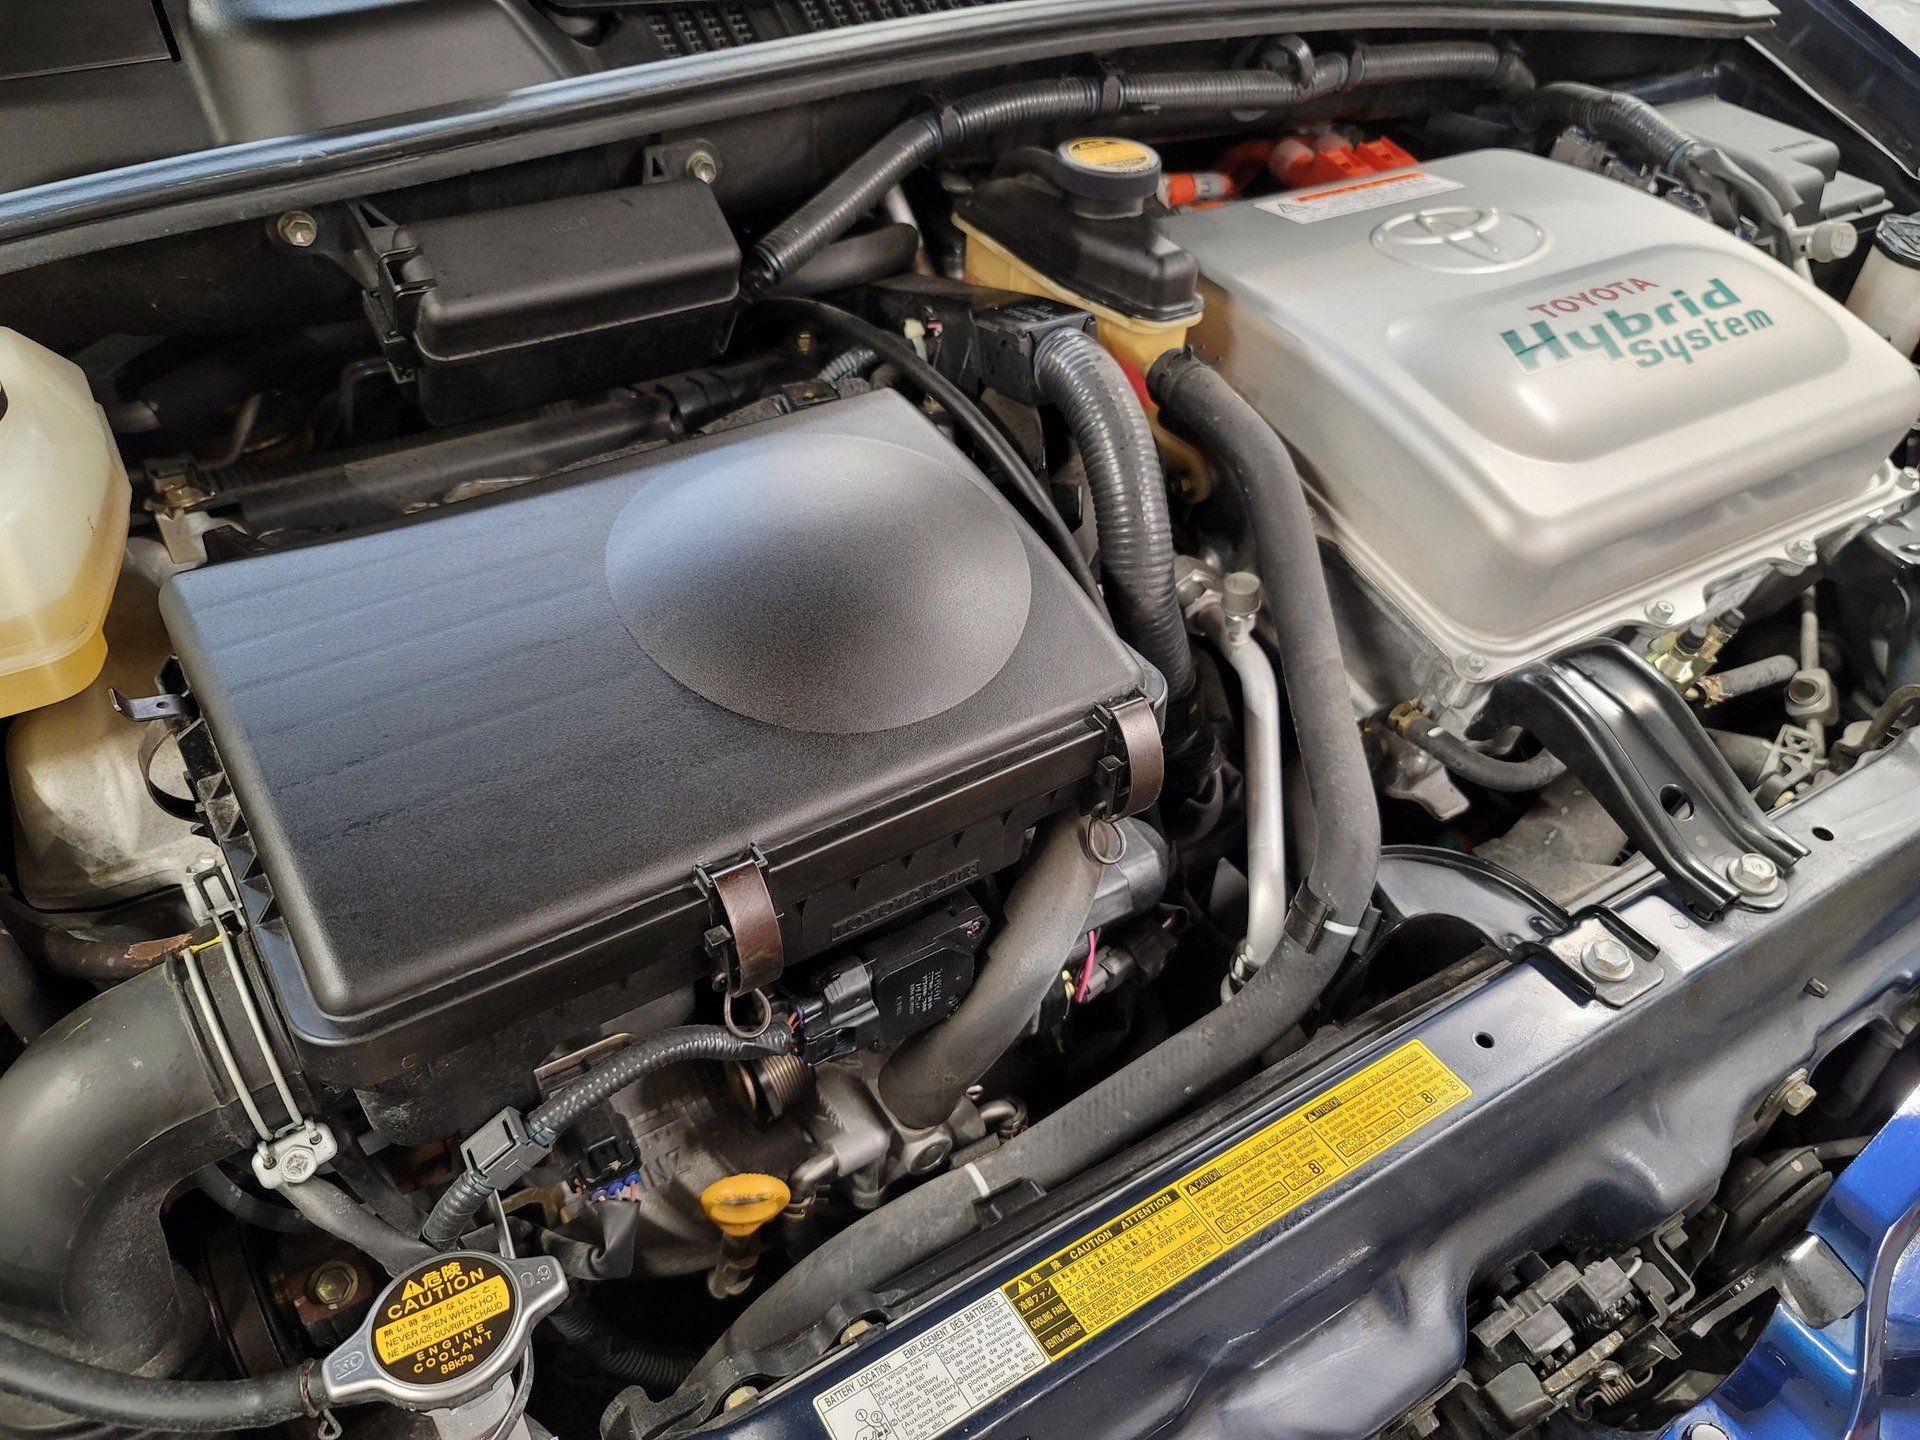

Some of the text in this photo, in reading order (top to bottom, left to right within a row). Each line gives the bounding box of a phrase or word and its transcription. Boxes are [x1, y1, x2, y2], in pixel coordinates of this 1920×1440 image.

[1527, 277, 1659, 319] TOYOTA
[1500, 278, 1742, 372] Hybrid
[1627, 308, 1775, 368] System
[1312, 1097, 1341, 1117] ATTENTION
[1419, 1092, 1434, 1104] 8
[1193, 1169, 1221, 1189] CAUTION
[1199, 1201, 1210, 1211] Air
[1209, 1180, 1245, 1205] conditioning
[1243, 1168, 1266, 1185] system
[1263, 1156, 1284, 1171] should
[1282, 1150, 1293, 1159] be
[1291, 1136, 1316, 1153] serviced
[1307, 1161, 1321, 1174] 8
[1193, 1184, 1221, 1205] Improper
[1204, 1208, 1216, 1219] by
[1214, 1193, 1240, 1213] qualified
[1267, 1167, 1282, 1178] See
[1242, 1223, 1252, 1232] BY
[1252, 1210, 1273, 1225] DENSO
[1272, 1184, 1313, 1212] CORPORATION
[1312, 1172, 1332, 1186] JAPAN
[1068, 1193, 1172, 1260] CAUTION ATTENTION
[1062, 1213, 1196, 1299] TO AVOID PERSONAL KEEP HANDS
[1066, 1219, 1201, 1305] AWAY FROM FANS MAY START AT ANY
[422, 1261, 463, 1287] 危険
[388, 1267, 484, 1319] CAUTION
[1071, 1275, 1123, 1311] TIME IGNITION IS
[386, 1292, 501, 1348] NEVER OPEN WHEN HOT.
[902, 1296, 999, 1359] EMPLACEMENT DES BATTERIES
[1029, 1302, 1067, 1329] COOLING FANS
[388, 1346, 401, 1359] NE
[402, 1333, 433, 1353] JAMAIS
[434, 1320, 465, 1339] OUVRIR
[413, 1330, 493, 1373] COOLANT
[416, 1323, 485, 1361] ENGINE
[938, 1327, 984, 1358] deux types de
[987, 1346, 997, 1355] de
[995, 1345, 1013, 1360] acide
[1014, 1340, 1022, 1348] et
[1043, 1321, 1081, 1350] VENTILATEURS
[440, 1354, 474, 1375] 88kPa
[870, 1348, 935, 1390] This vehicle has two
[953, 1345, 984, 1367] de nickel
[990, 1369, 1007, 1383] pour
[1007, 1361, 1019, 1371] les
[823, 1360, 891, 1407] BATTERY LOCATION
[873, 1383, 893, 1398] types
[888, 1373, 939, 1410] Hydride Battery
[915, 1381, 957, 1410] Acid Battery
[923, 1376, 950, 1396] Battery)
[935, 1388, 961, 1408] Battery
[904, 1426, 916, 1437] for
